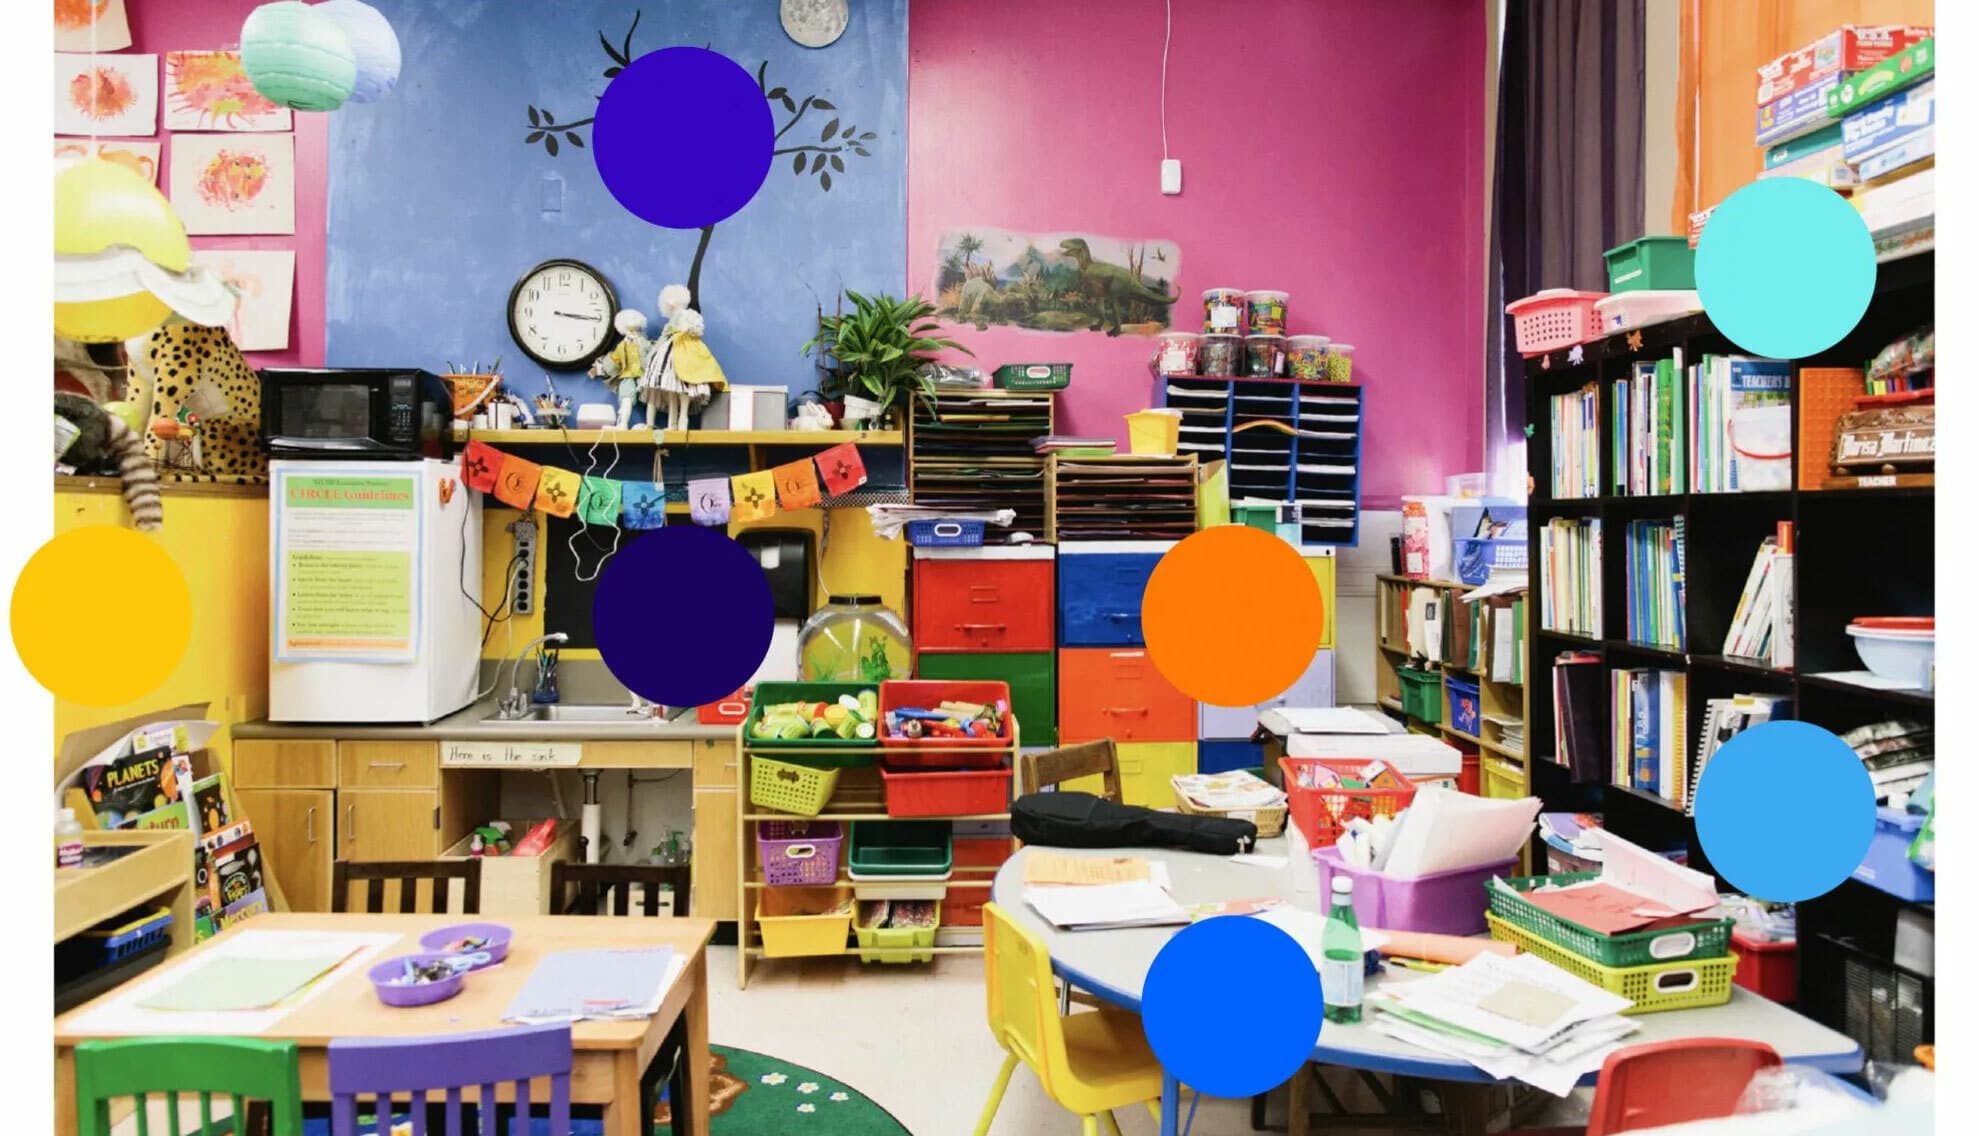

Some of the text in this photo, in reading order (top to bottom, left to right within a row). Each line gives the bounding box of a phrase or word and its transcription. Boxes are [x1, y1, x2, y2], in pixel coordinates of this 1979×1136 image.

[543, 276, 551, 291] 11
[559, 272, 571, 287] 12
[529, 289, 540, 302] 10
[589, 291, 599, 305] 2
[289, 488, 409, 502] CIRCLE Guidelines
[449, 746, 557, 761] Here is the sink
[106, 758, 160, 789] PLANETS
